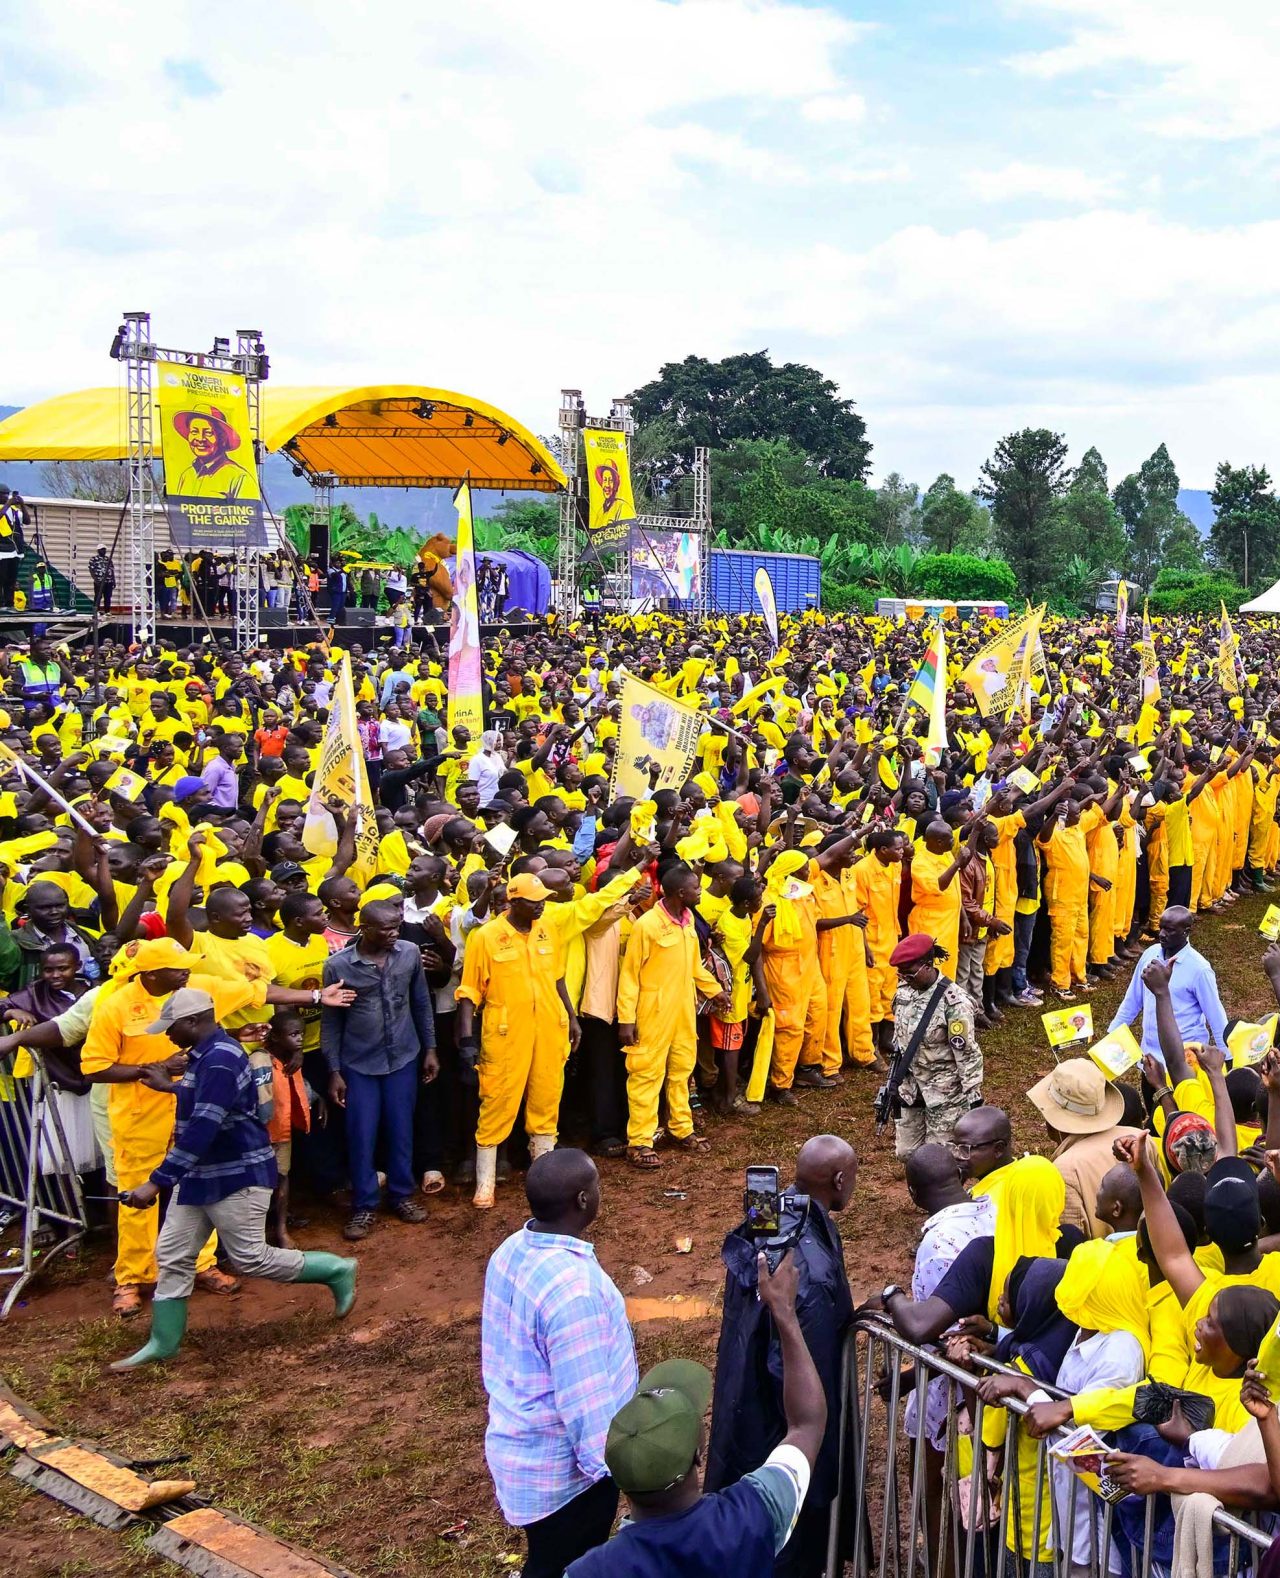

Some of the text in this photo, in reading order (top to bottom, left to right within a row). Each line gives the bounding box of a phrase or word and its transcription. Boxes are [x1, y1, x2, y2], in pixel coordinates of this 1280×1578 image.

[184, 371, 223, 386] YOWERI
[181, 379, 229, 395] MUSEVENI
[180, 503, 255, 516] PROTECTING
[187, 514, 250, 526] THE GAINS
